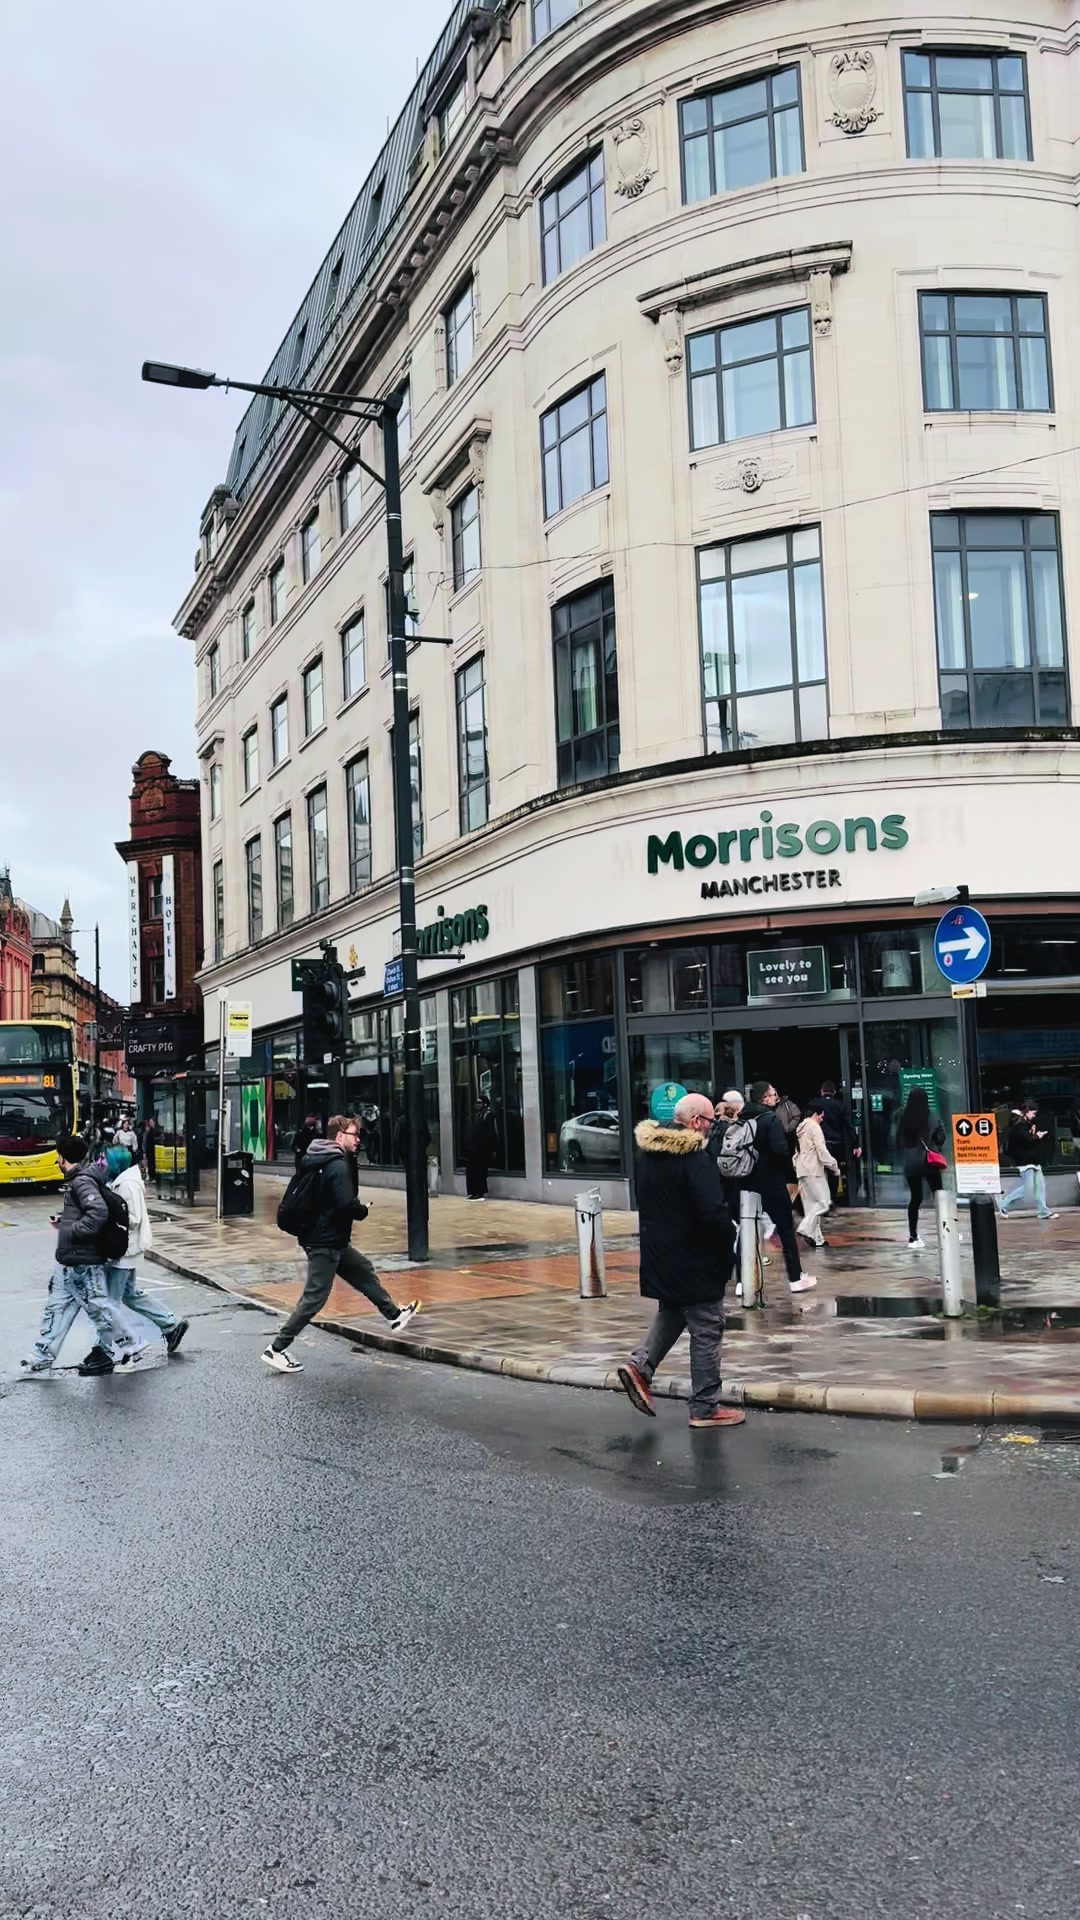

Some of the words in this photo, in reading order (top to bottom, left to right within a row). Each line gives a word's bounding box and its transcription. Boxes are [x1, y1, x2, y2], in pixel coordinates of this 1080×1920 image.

[647, 810, 909, 874] Morrisons
[700, 868, 842, 899] MANCHESTER
[130, 876, 138, 988] MERCHANTS
[415, 904, 490, 954] orrisons
[759, 960, 796, 972] Lovely
[799, 960, 812, 969] to
[765, 975, 784, 984] see
[786, 974, 808, 985] you
[128, 1043, 157, 1054] CRAFTY
[158, 1042, 174, 1052] PIG
[130, 1066, 136, 1075] 4
